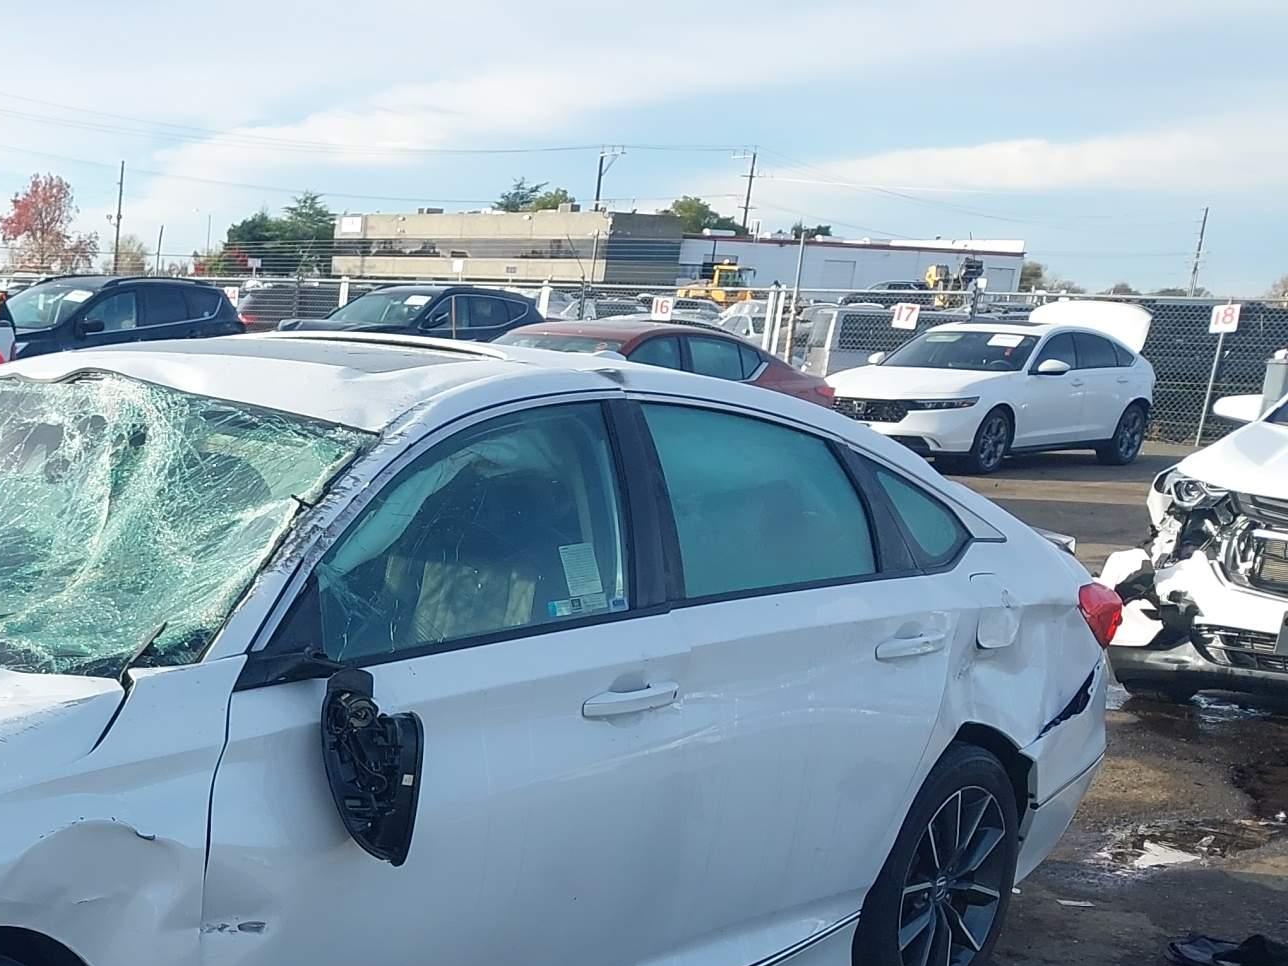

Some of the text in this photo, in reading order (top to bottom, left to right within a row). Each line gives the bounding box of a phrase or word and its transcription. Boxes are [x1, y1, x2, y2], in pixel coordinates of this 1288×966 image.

[654, 299, 670, 314] 16
[896, 305, 917, 322] 17
[1214, 307, 1235, 326] 18
